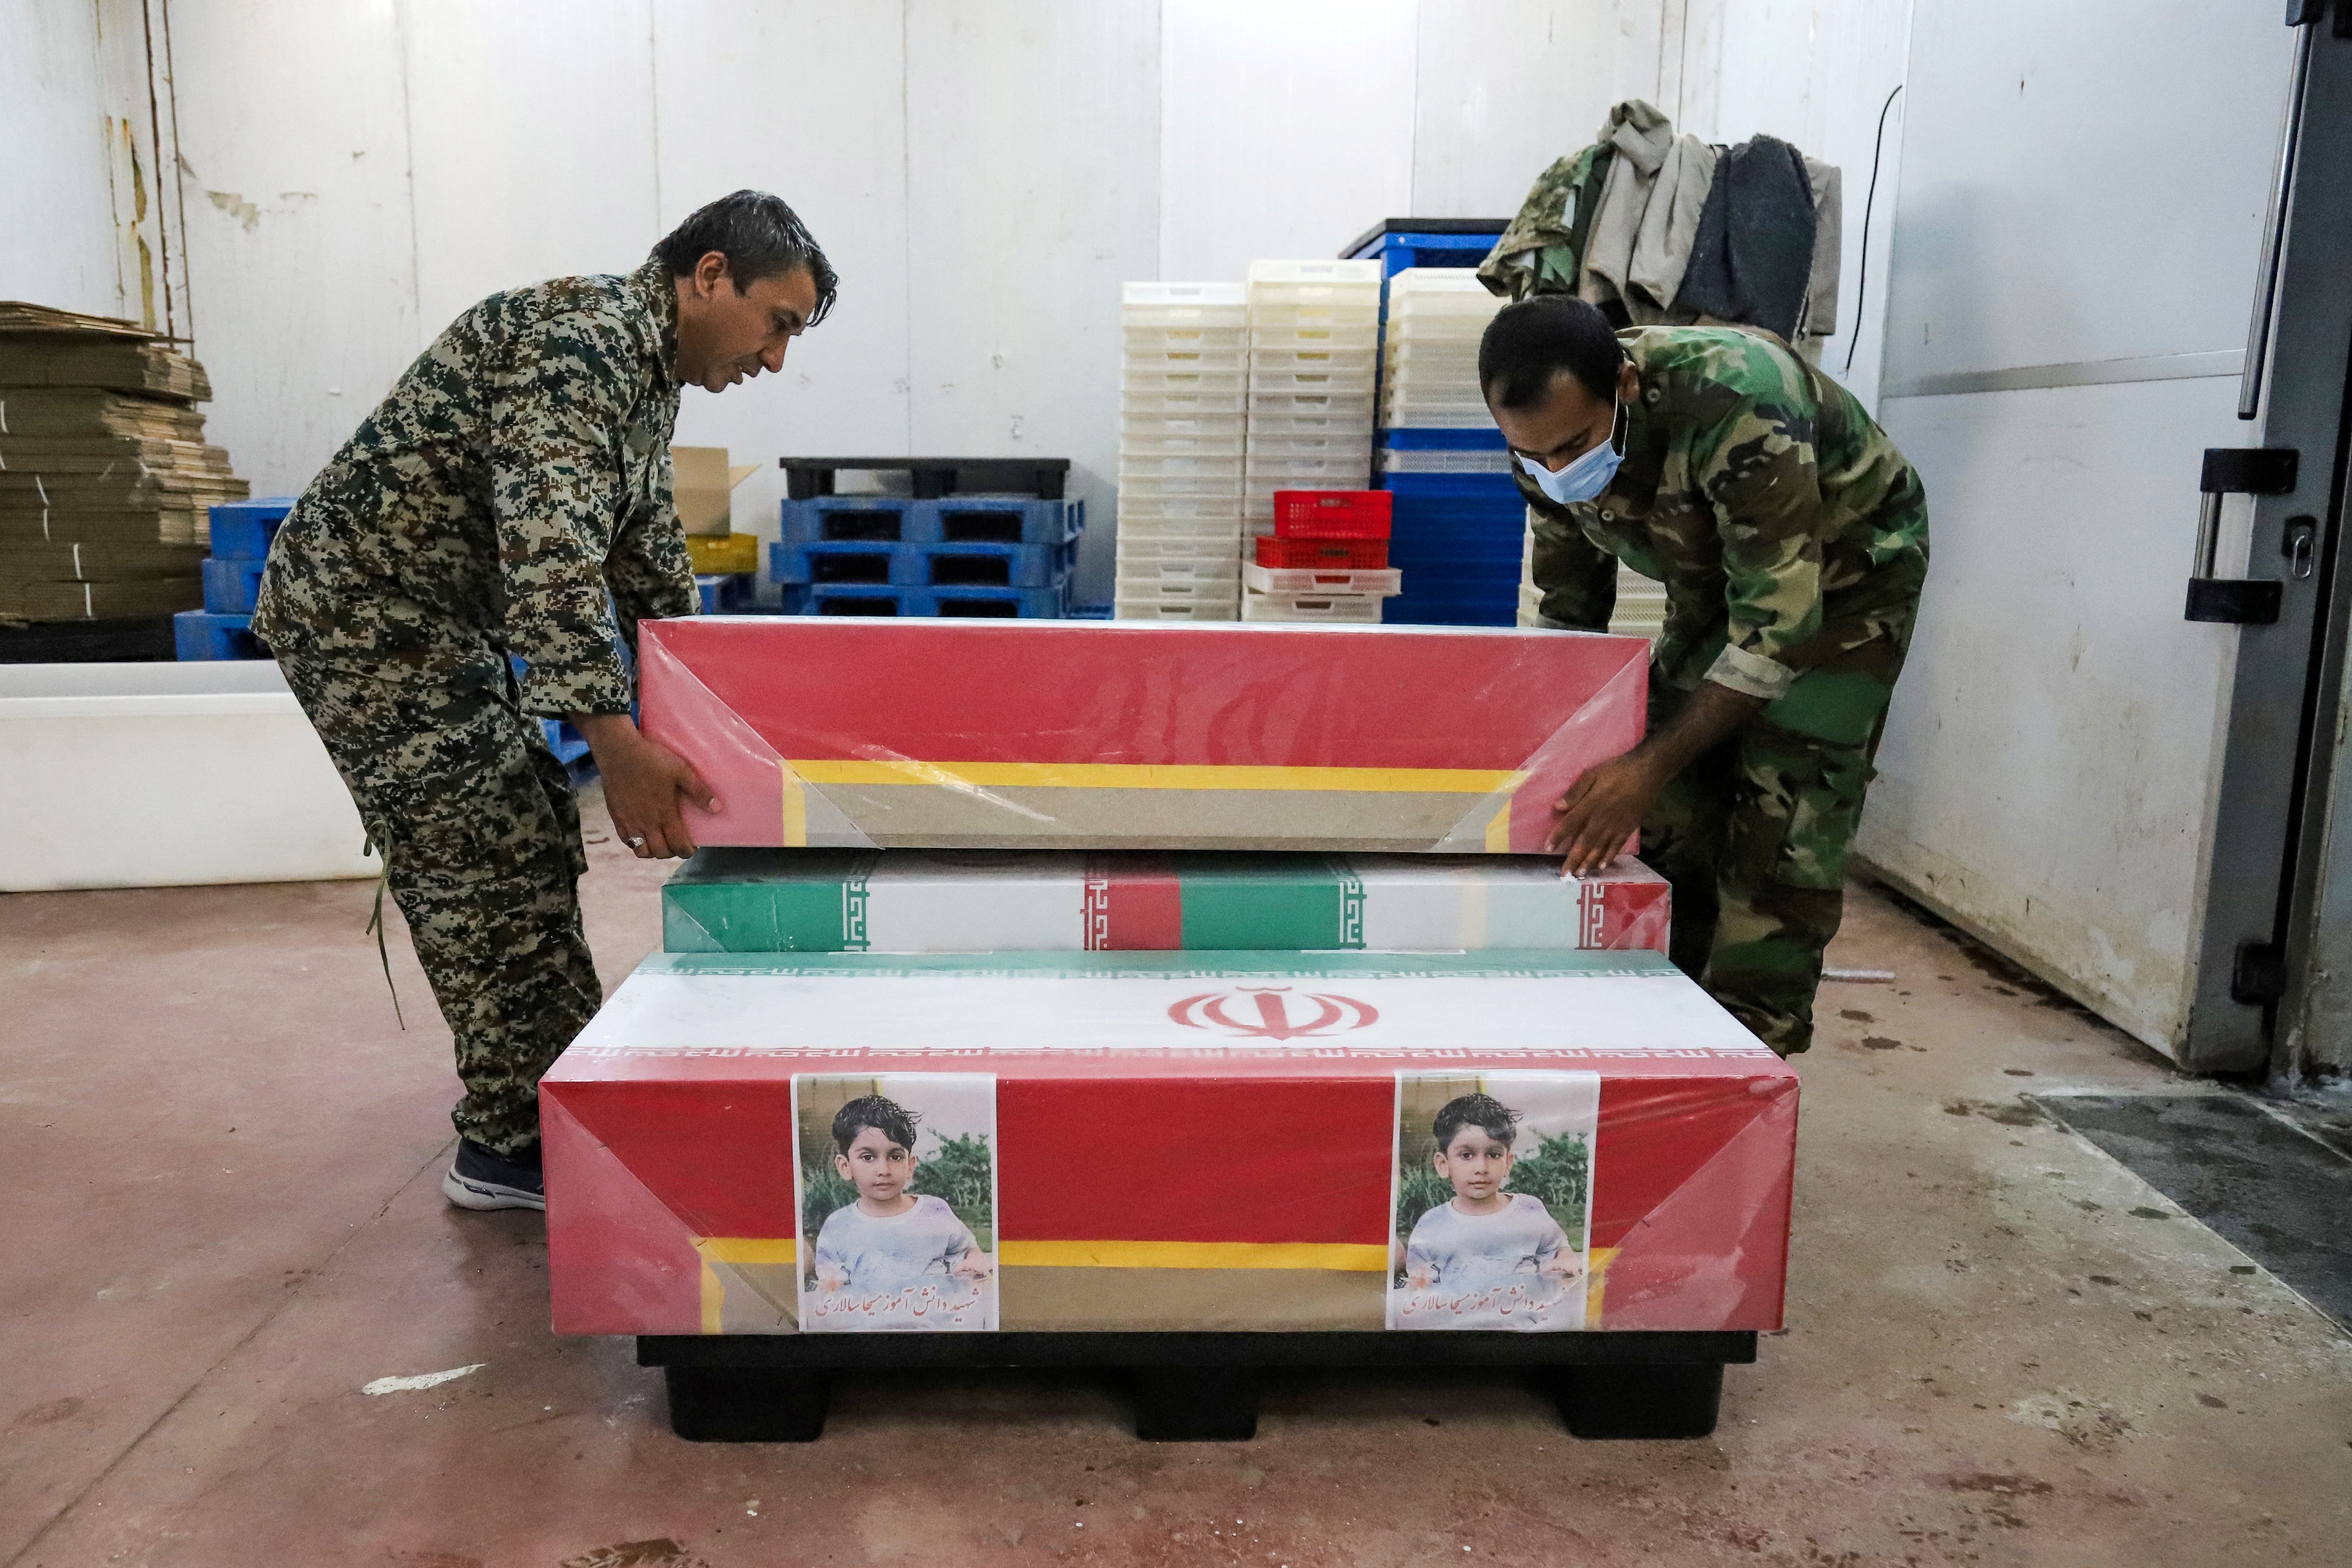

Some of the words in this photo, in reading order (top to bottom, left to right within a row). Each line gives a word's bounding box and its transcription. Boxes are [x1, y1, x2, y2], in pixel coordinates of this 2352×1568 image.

[815, 1296, 859, 1317] سالاری
[883, 1287, 915, 1311] آموز
[913, 1286, 947, 1316] دانش
[951, 1287, 980, 1322] شهید
[1402, 1296, 1447, 1315] سالاری
[1470, 1287, 1502, 1311] آموز
[1500, 1285, 1534, 1315] دانش
